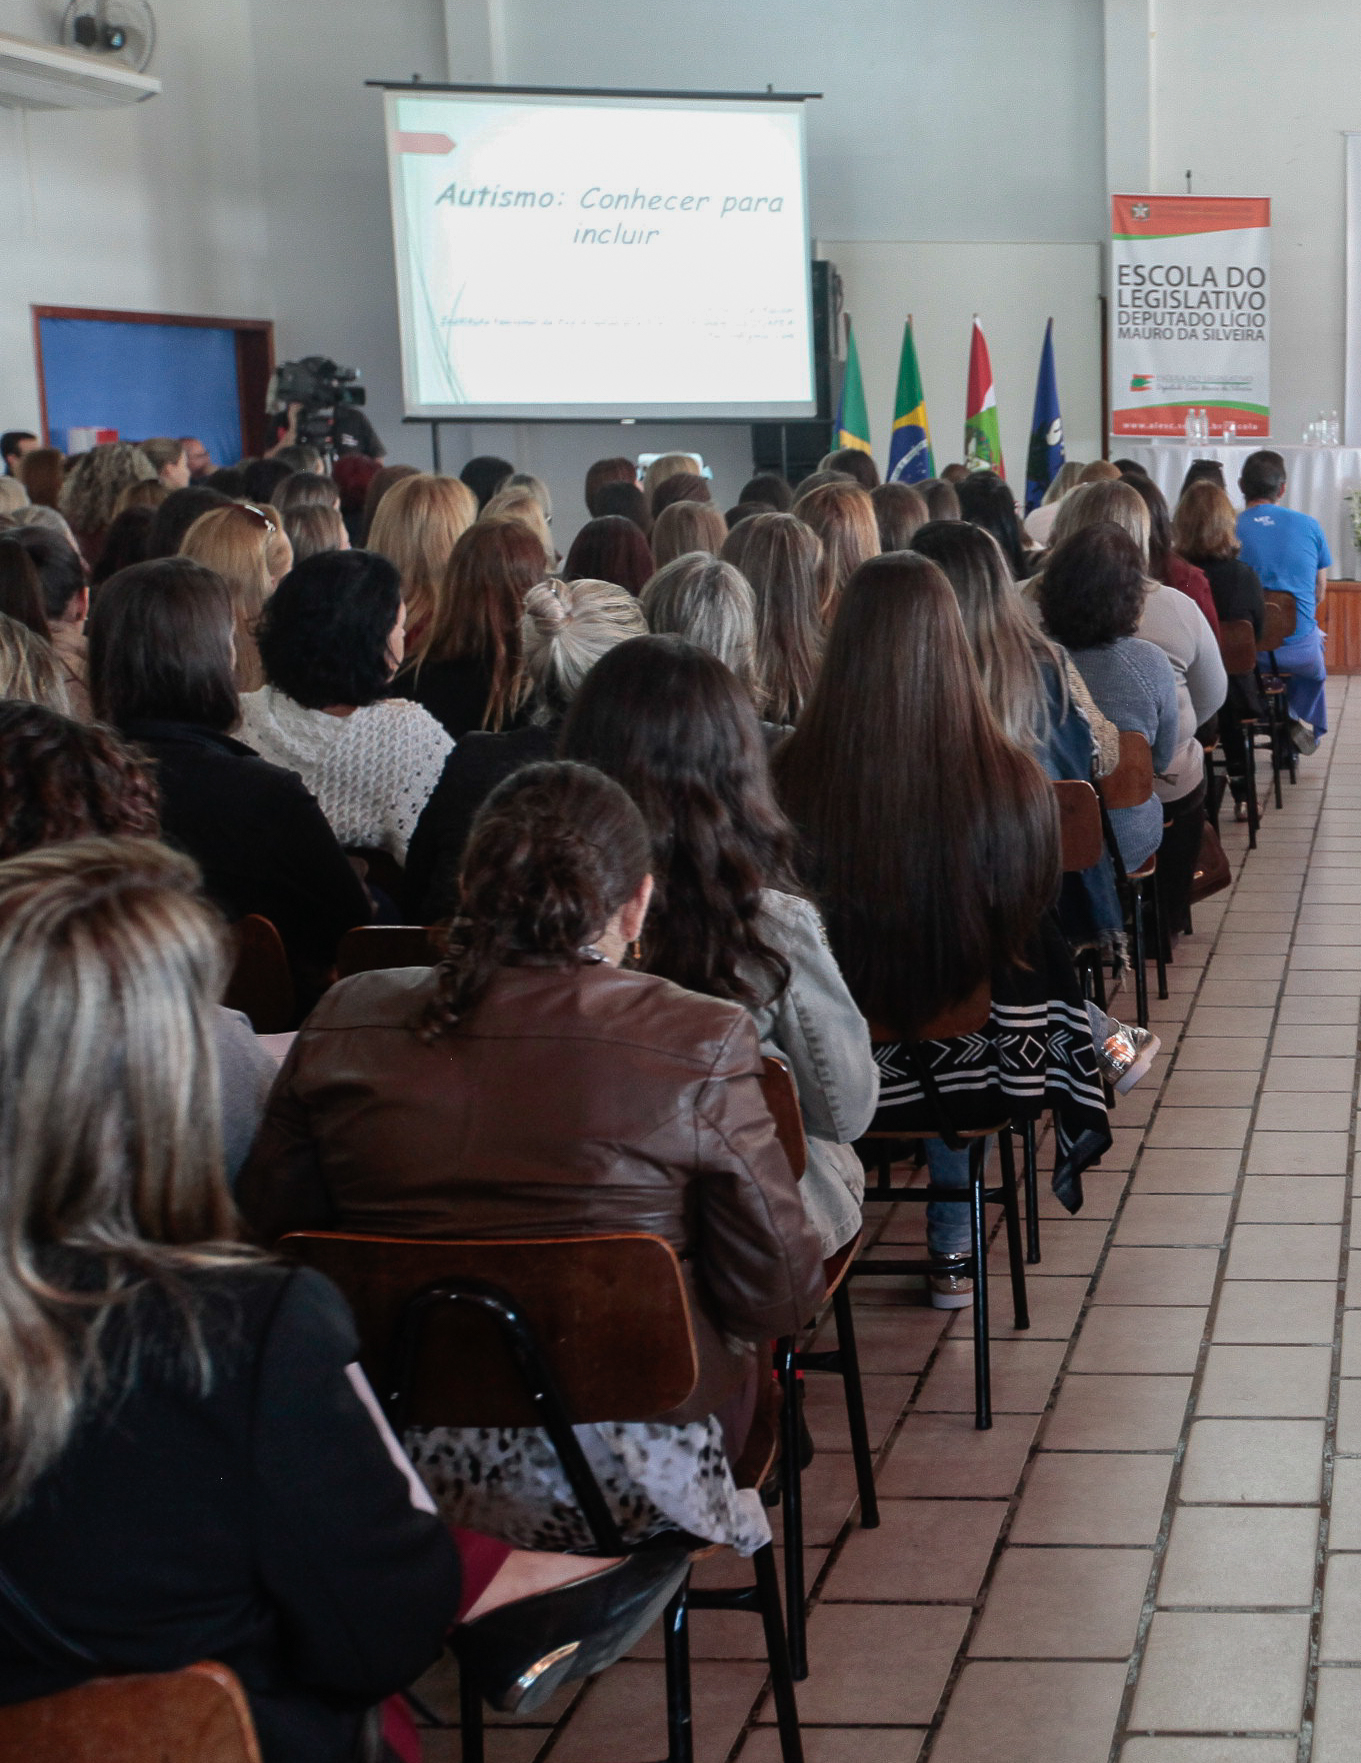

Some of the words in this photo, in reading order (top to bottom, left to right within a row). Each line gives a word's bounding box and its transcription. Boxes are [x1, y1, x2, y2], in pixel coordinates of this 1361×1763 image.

[435, 183, 565, 208] Autismo:
[580, 187, 709, 212] Conhecer
[720, 193, 784, 217] para
[573, 222, 660, 245] incluir
[1118, 264, 1218, 288] ESCOLA
[1227, 266, 1266, 289] DO
[1117, 288, 1266, 311] LEGISLATIVO
[1118, 311, 1216, 327] DEPUTADO
[1221, 311, 1266, 328] LÍCIO
[1118, 327, 1173, 340] MAURO
[1177, 328, 1199, 341] DA
[1203, 328, 1265, 341] SILVEIRA
